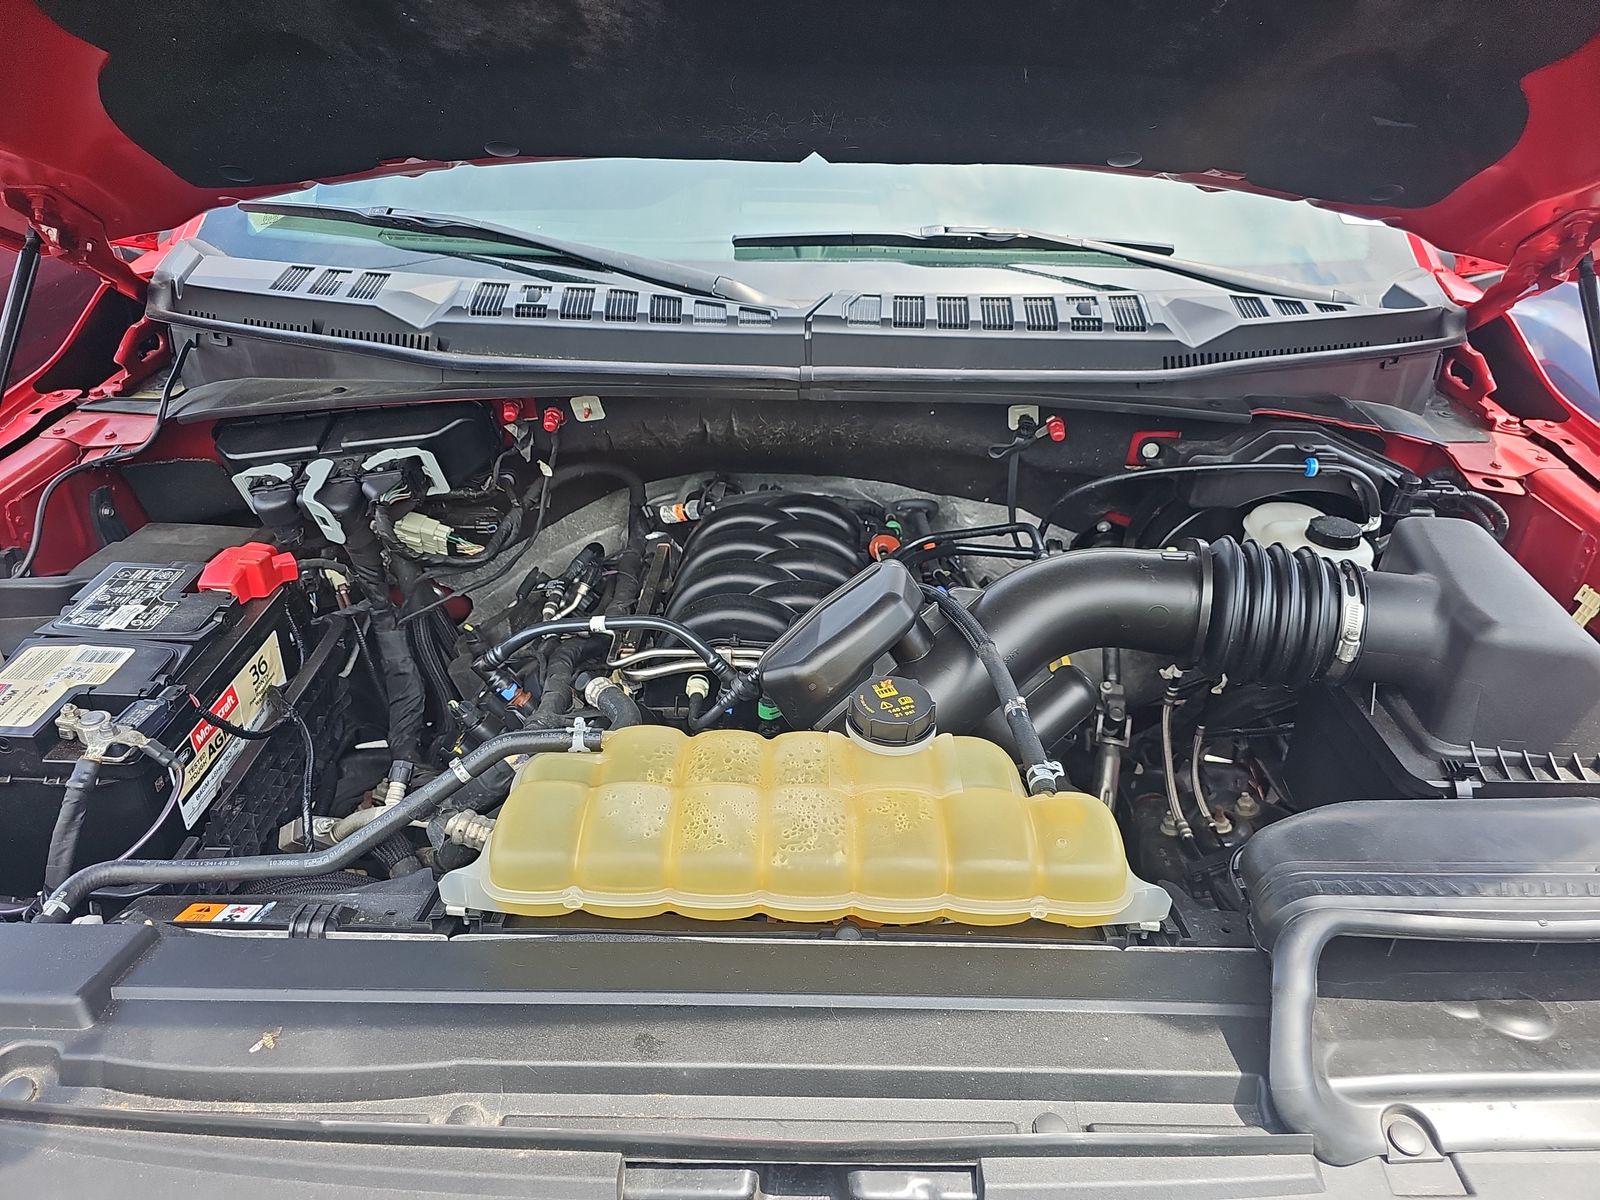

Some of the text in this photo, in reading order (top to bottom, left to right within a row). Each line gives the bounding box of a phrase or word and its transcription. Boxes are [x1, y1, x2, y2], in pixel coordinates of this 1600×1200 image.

[249, 655, 268, 686] 36
[195, 694, 236, 745] Mocraft
[187, 751, 206, 775] TESTED
[190, 757, 208, 782] TOUGH
